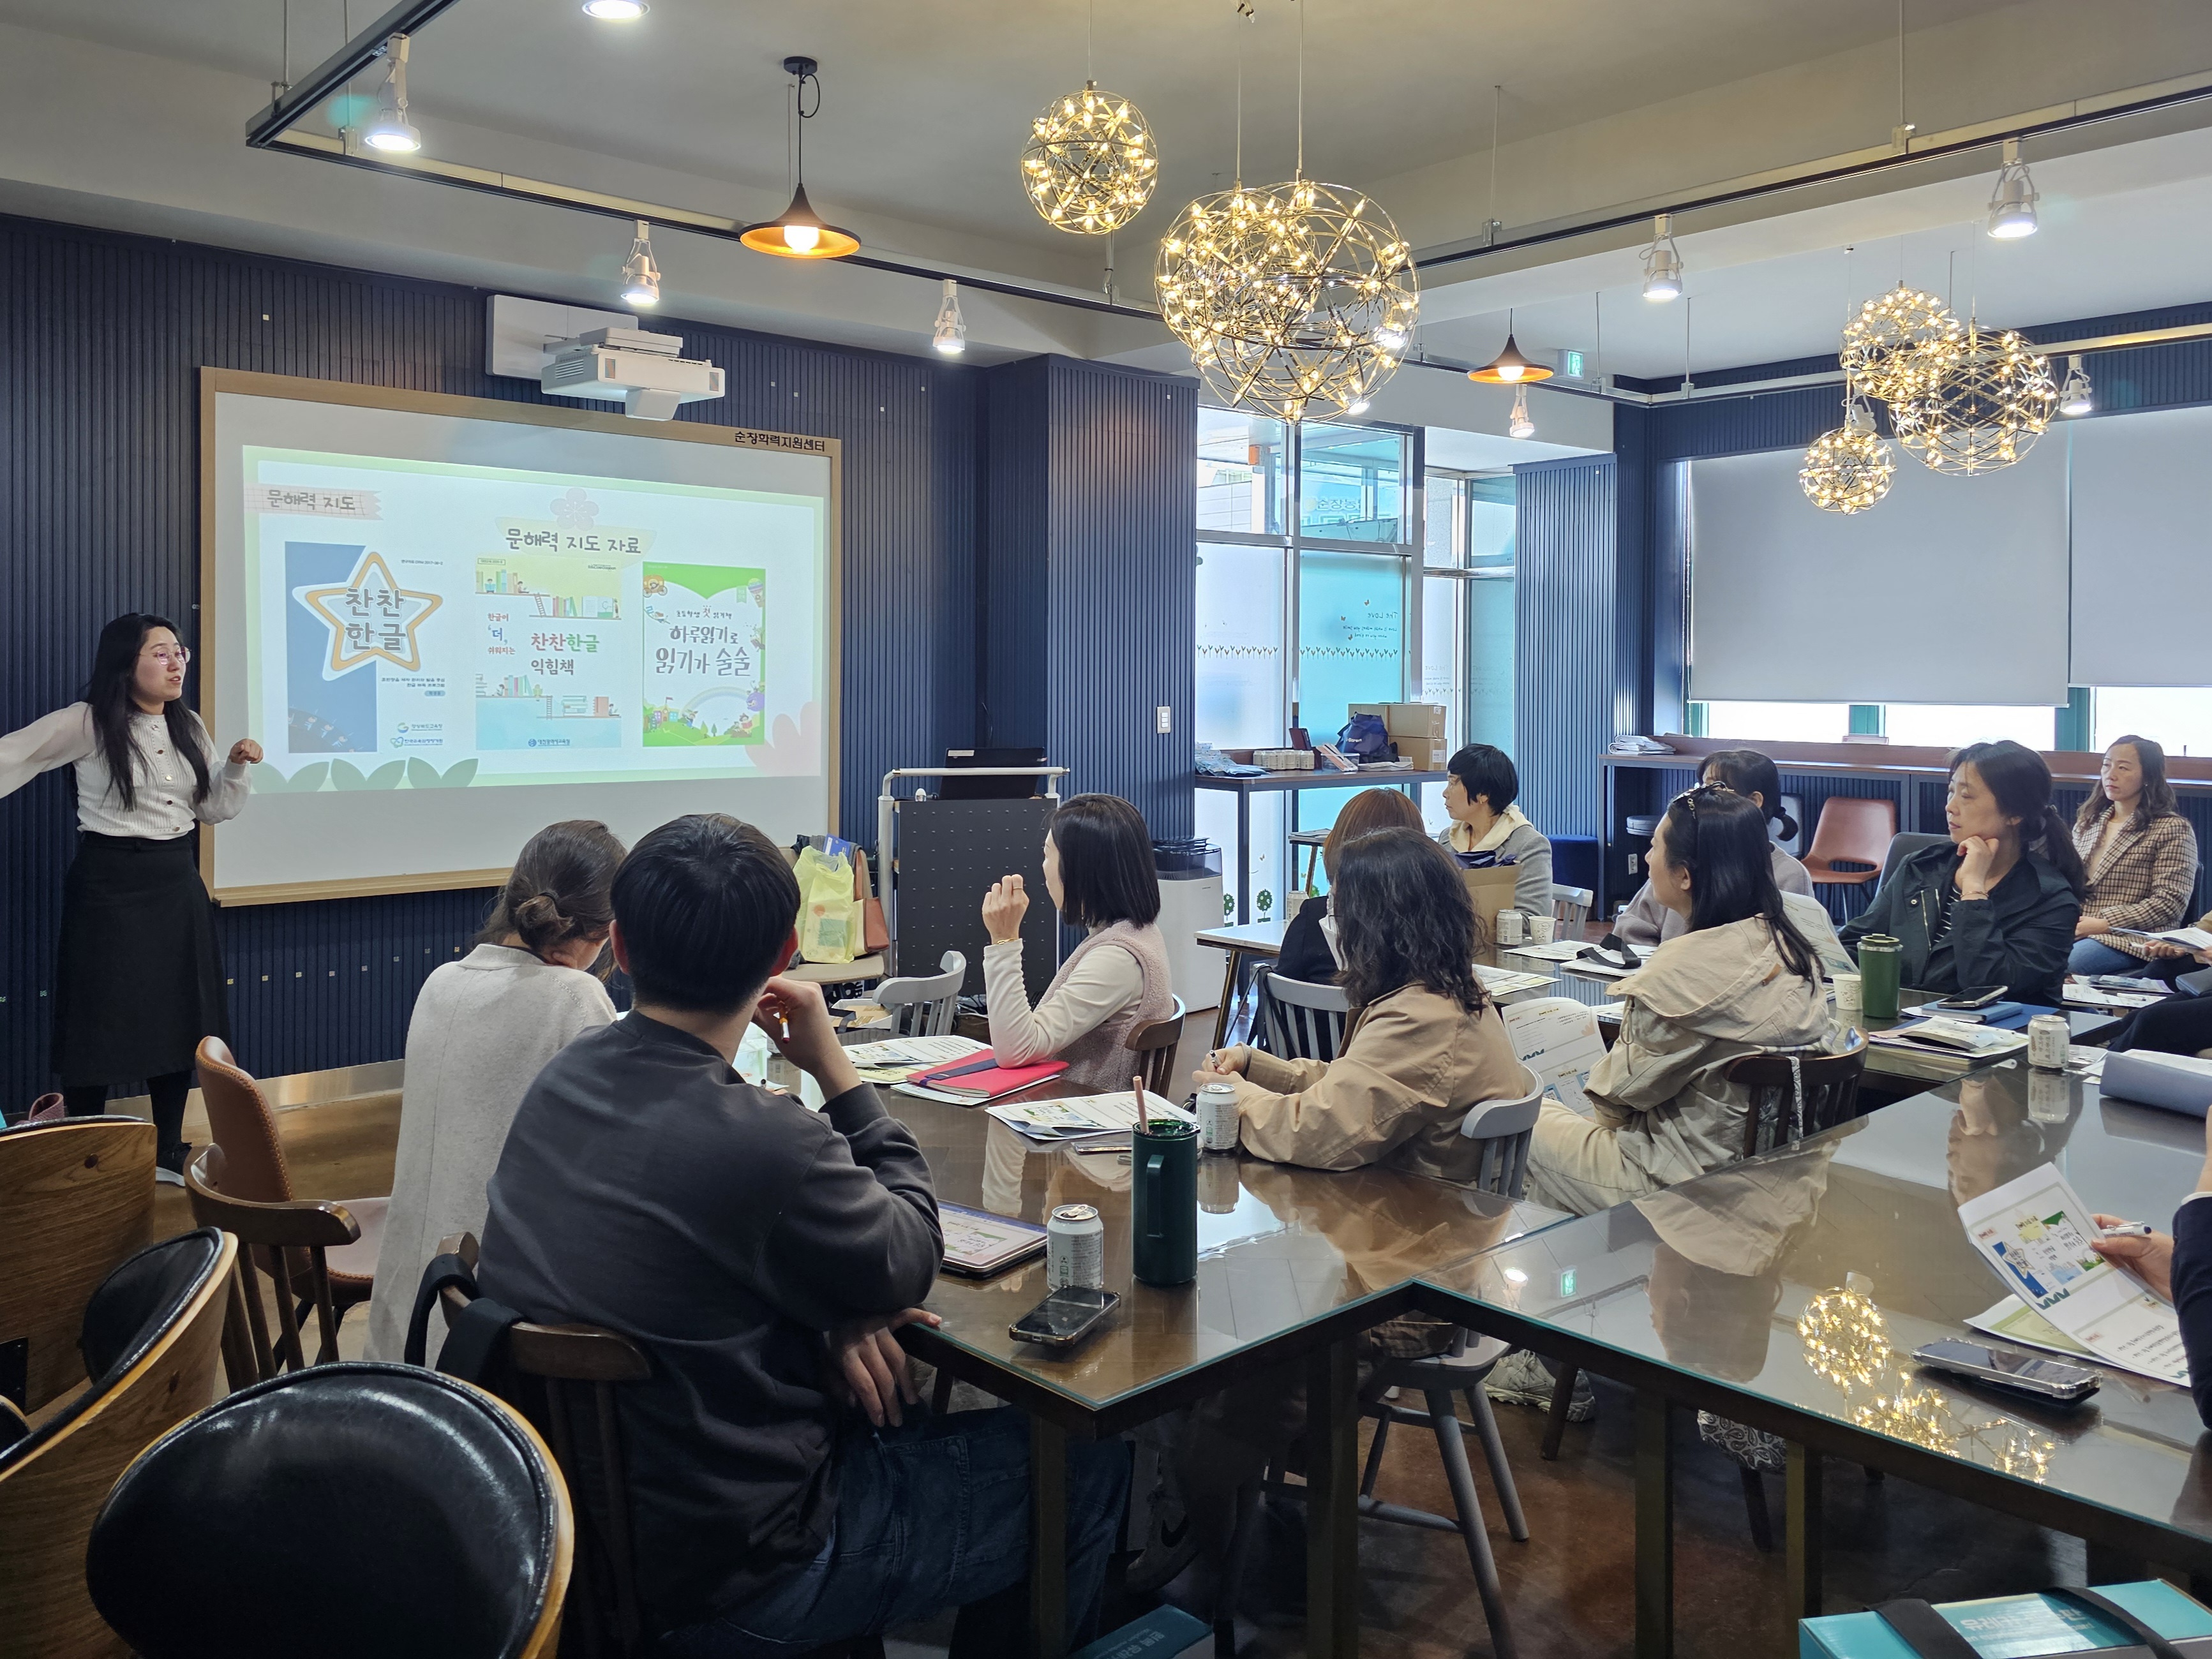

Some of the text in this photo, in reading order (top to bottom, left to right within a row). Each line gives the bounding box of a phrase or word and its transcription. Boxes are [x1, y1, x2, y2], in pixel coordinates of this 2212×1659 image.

[735, 431, 825, 452] 순창학력지원센터
[267, 489, 355, 510] 문해력 지도
[505, 528, 641, 554] 문해력 지도 자료
[345, 588, 405, 618] 찬찬
[488, 613, 509, 621] 한글이
[345, 621, 407, 651] 한글
[531, 632, 599, 653] 찬찬한글
[669, 625, 739, 644] 하루읽기로
[488, 646, 516, 655] 쉬워지는
[655, 646, 751, 676] 읽기가 술술
[531, 658, 574, 676] 익힘책
